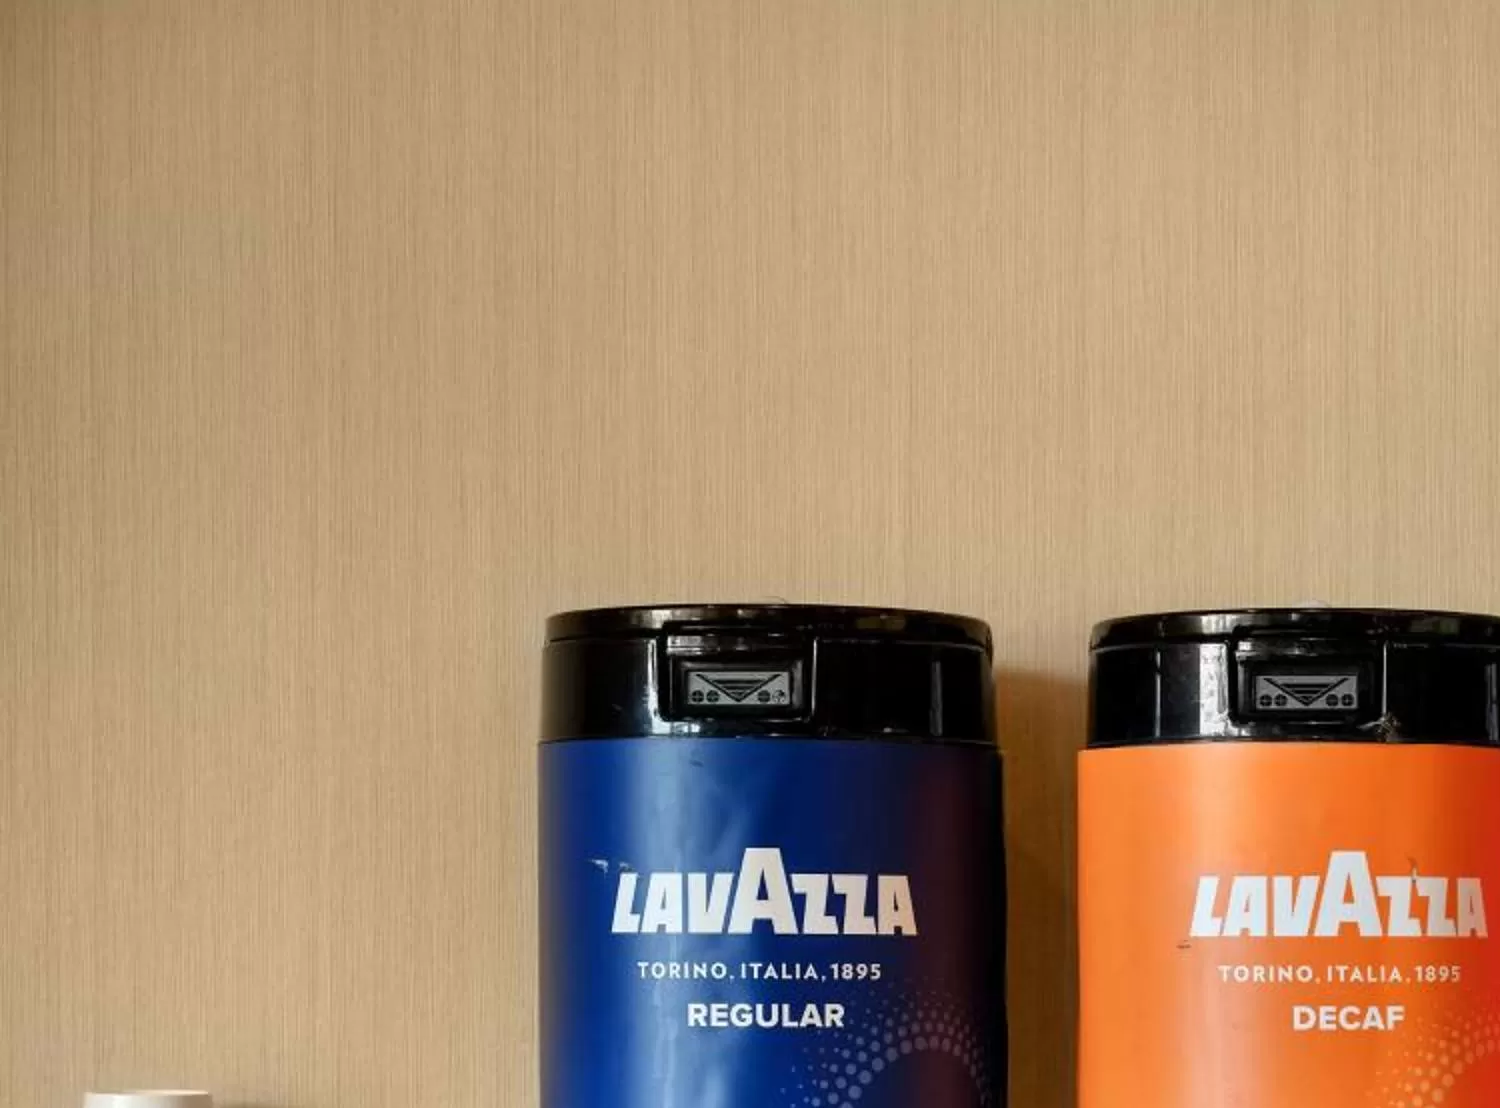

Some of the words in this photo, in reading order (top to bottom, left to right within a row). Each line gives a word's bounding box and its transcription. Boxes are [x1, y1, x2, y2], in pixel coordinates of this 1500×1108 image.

[611, 847, 917, 935] LAVAZZA
[1189, 850, 1488, 938] LAVAZZA
[830, 963, 882, 980] 1895
[1414, 966, 1461, 983] 1895
[687, 1003, 844, 1028] REGULAR
[1292, 1005, 1404, 1030] DECAF
